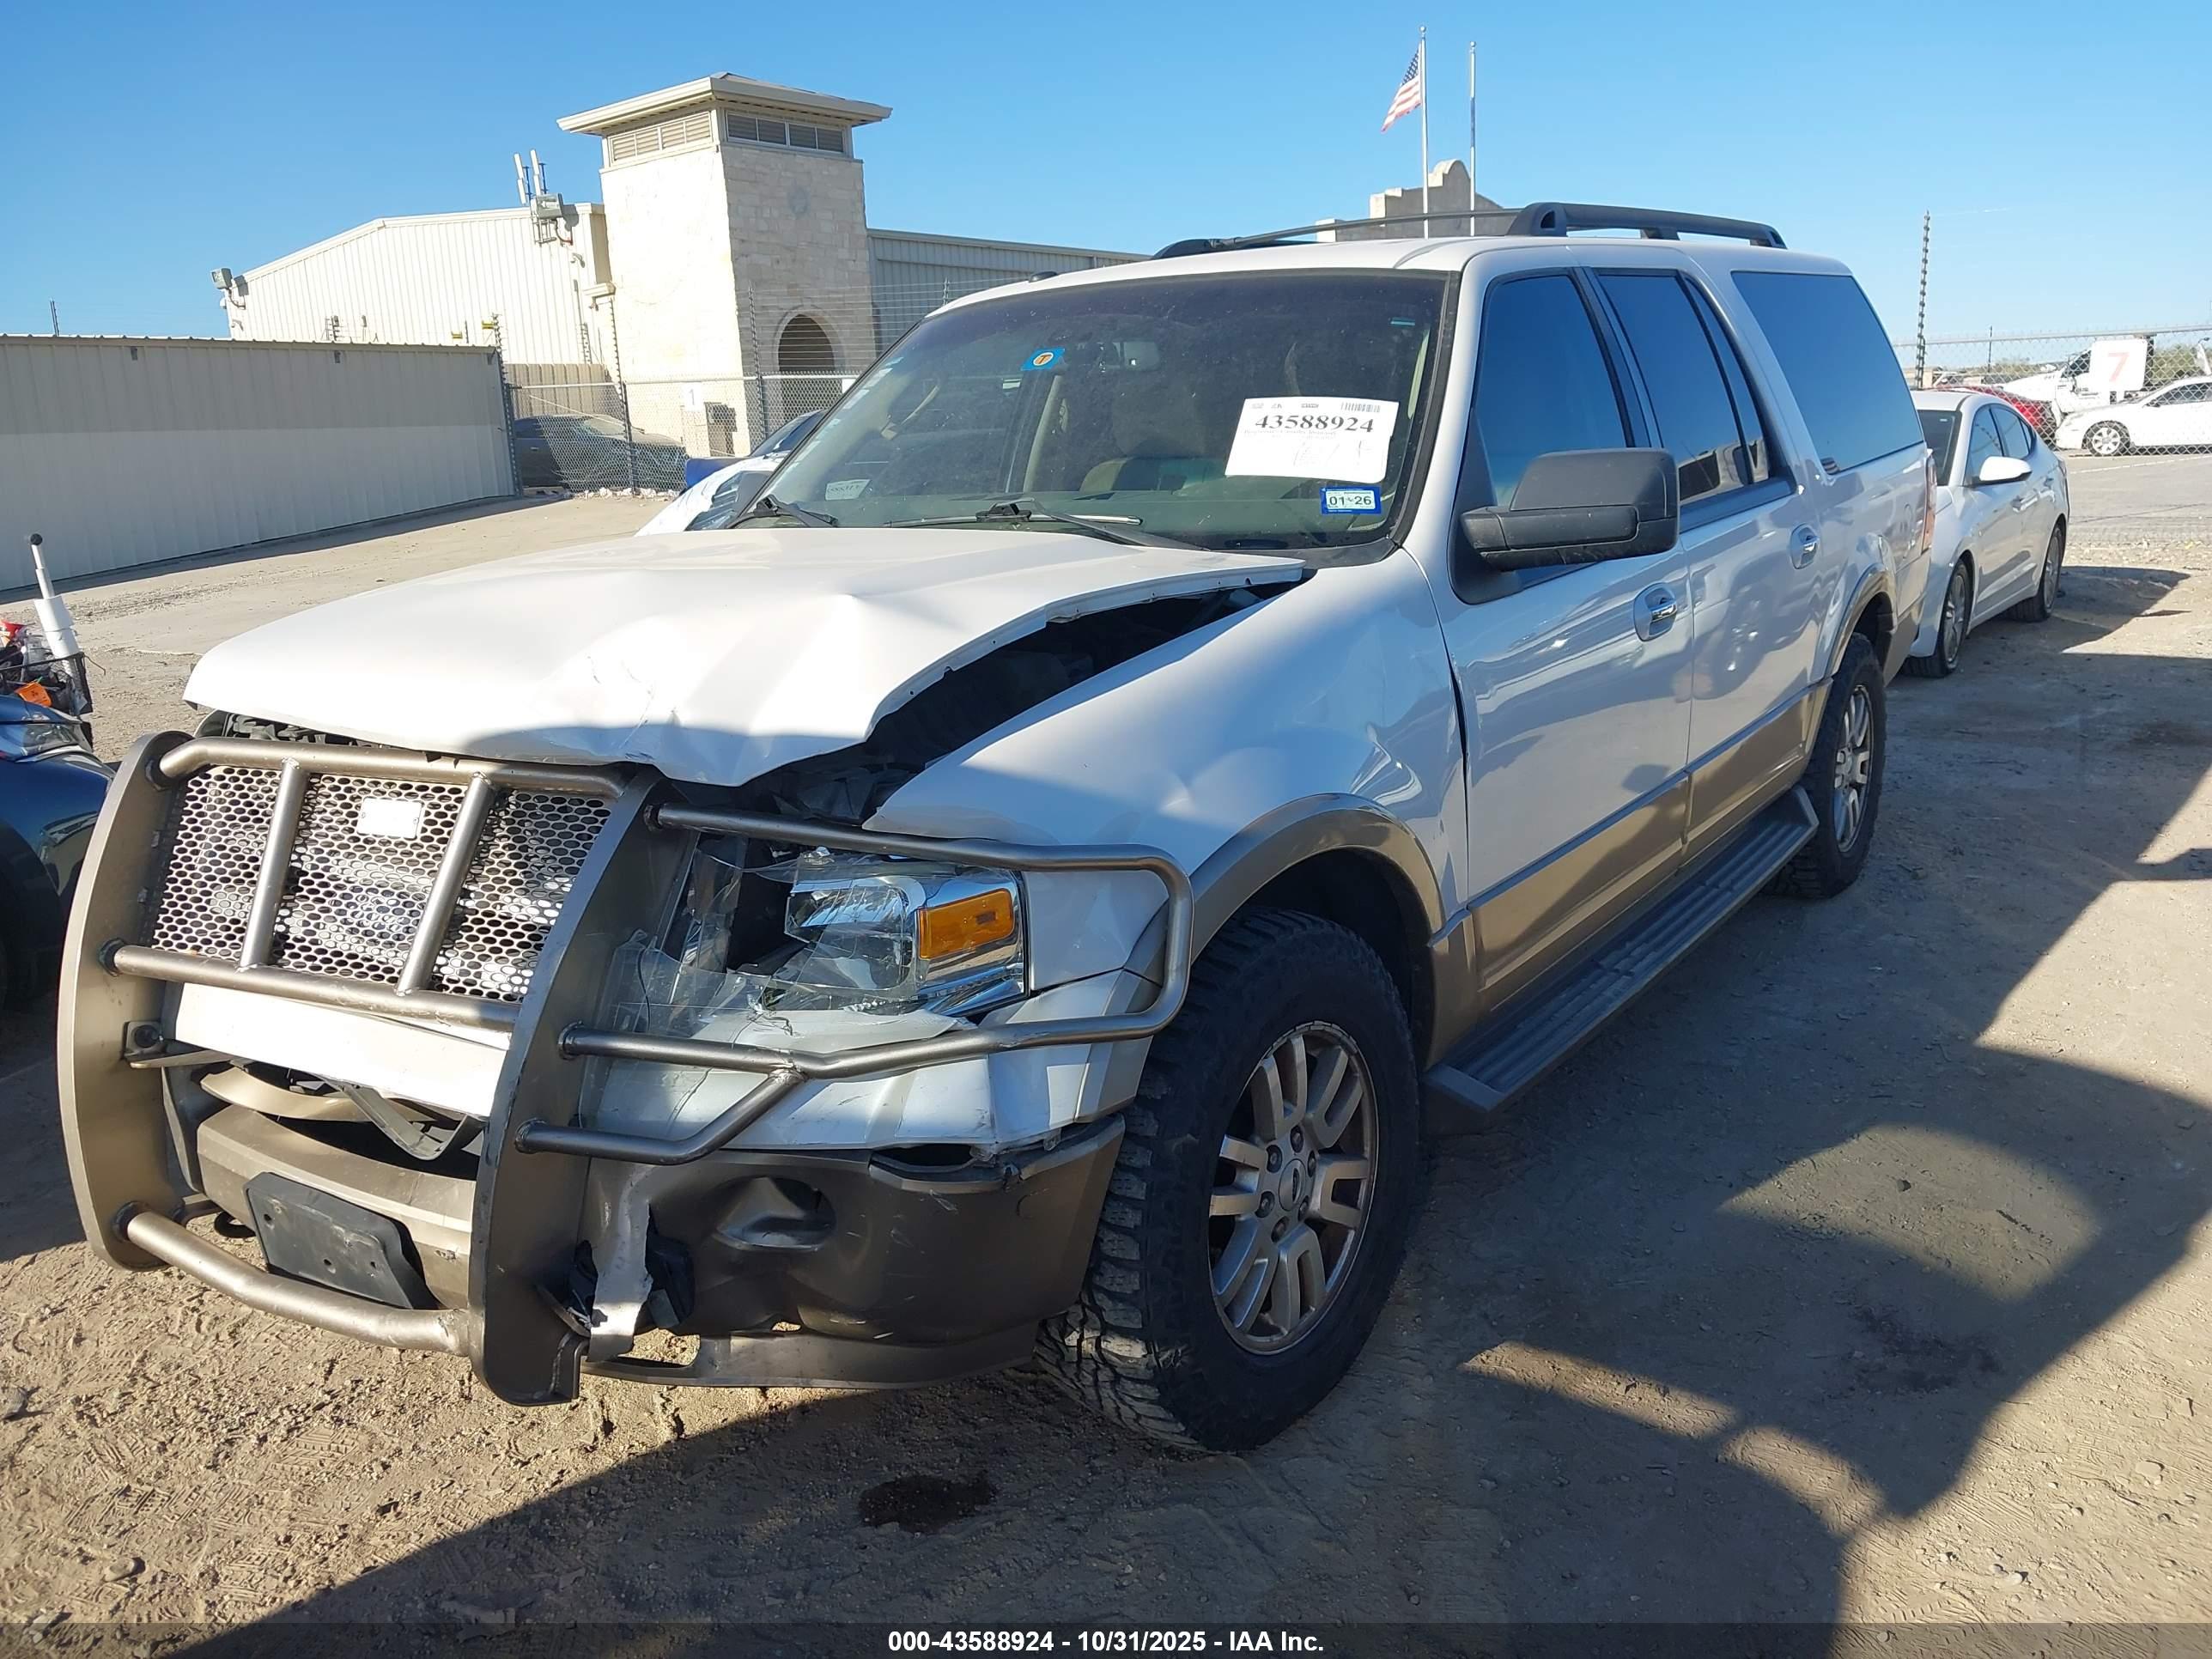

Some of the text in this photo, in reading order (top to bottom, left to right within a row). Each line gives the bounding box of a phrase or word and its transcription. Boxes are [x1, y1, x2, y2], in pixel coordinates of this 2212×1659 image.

[2108, 353, 2130, 382] 7
[689, 389, 694, 405] 1
[1255, 415, 1374, 433] 43588924
[1329, 495, 1371, 506] 01 26
